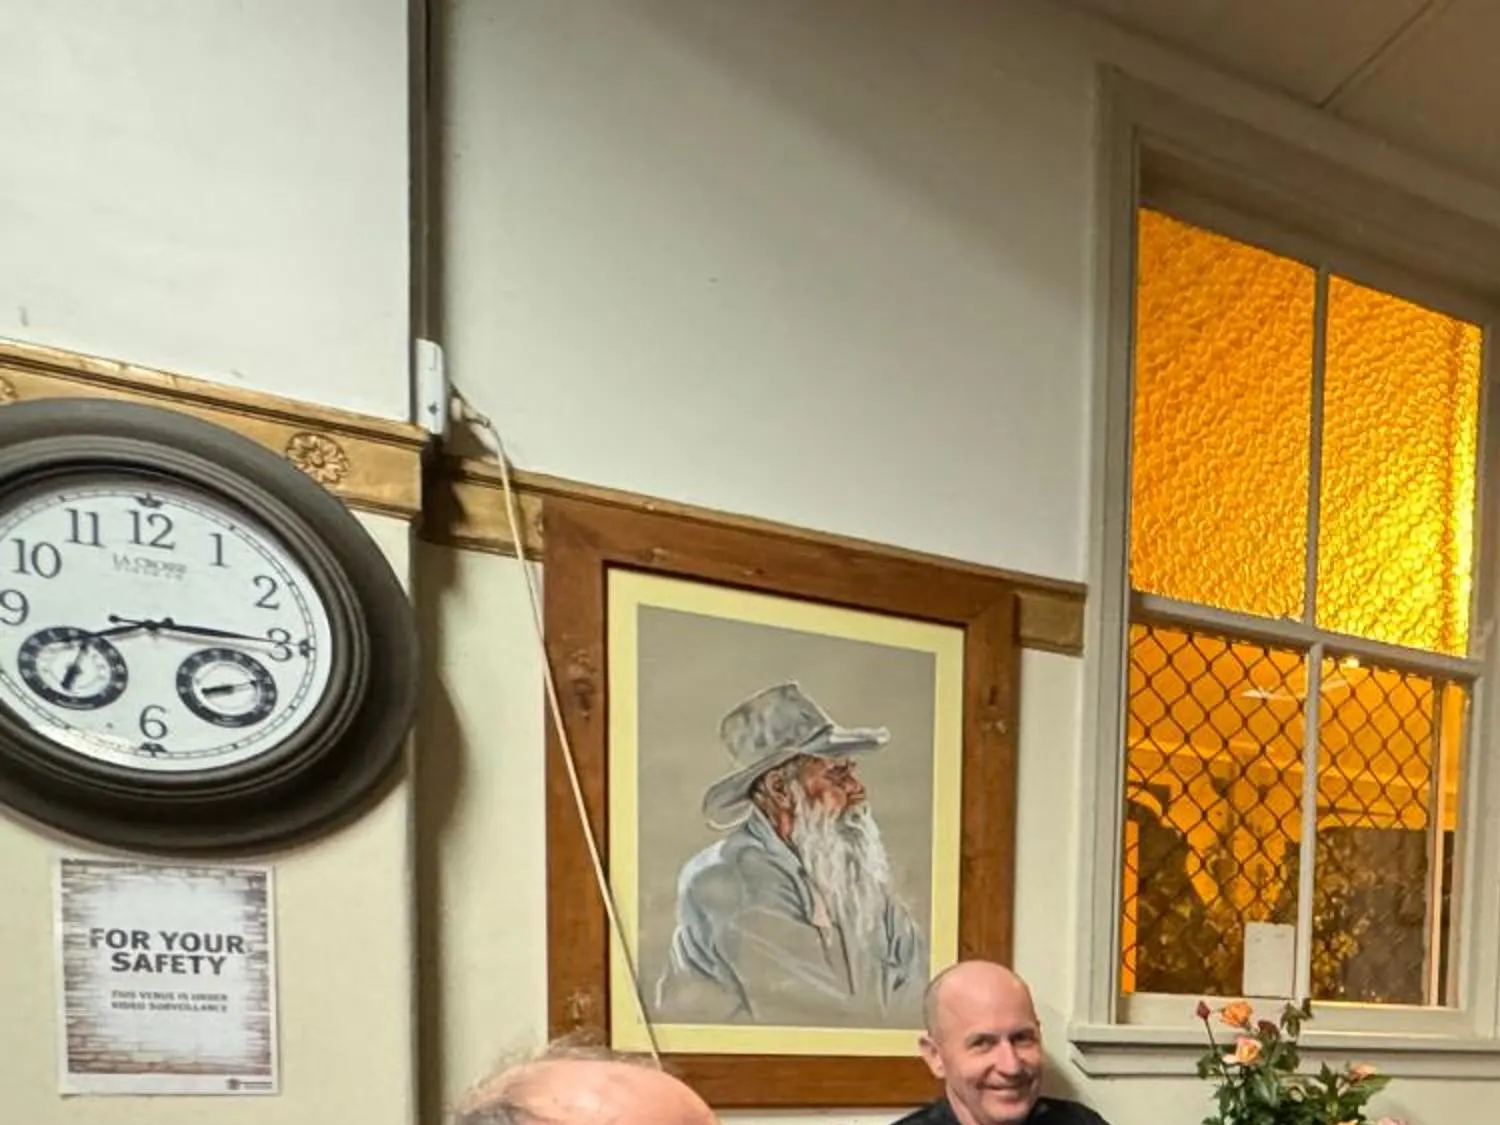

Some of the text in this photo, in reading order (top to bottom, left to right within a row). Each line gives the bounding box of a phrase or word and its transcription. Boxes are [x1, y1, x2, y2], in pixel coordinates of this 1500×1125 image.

[66, 508, 107, 549] 11
[128, 509, 176, 550] 12
[11, 538, 63, 579] 10
[209, 532, 230, 568] 1
[0, 589, 30, 627] 9
[253, 575, 281, 610] 2
[267, 628, 293, 662] 3
[139, 705, 169, 740] 6
[89, 927, 246, 954] FOR YOUR
[111, 952, 228, 975] SAFETY
